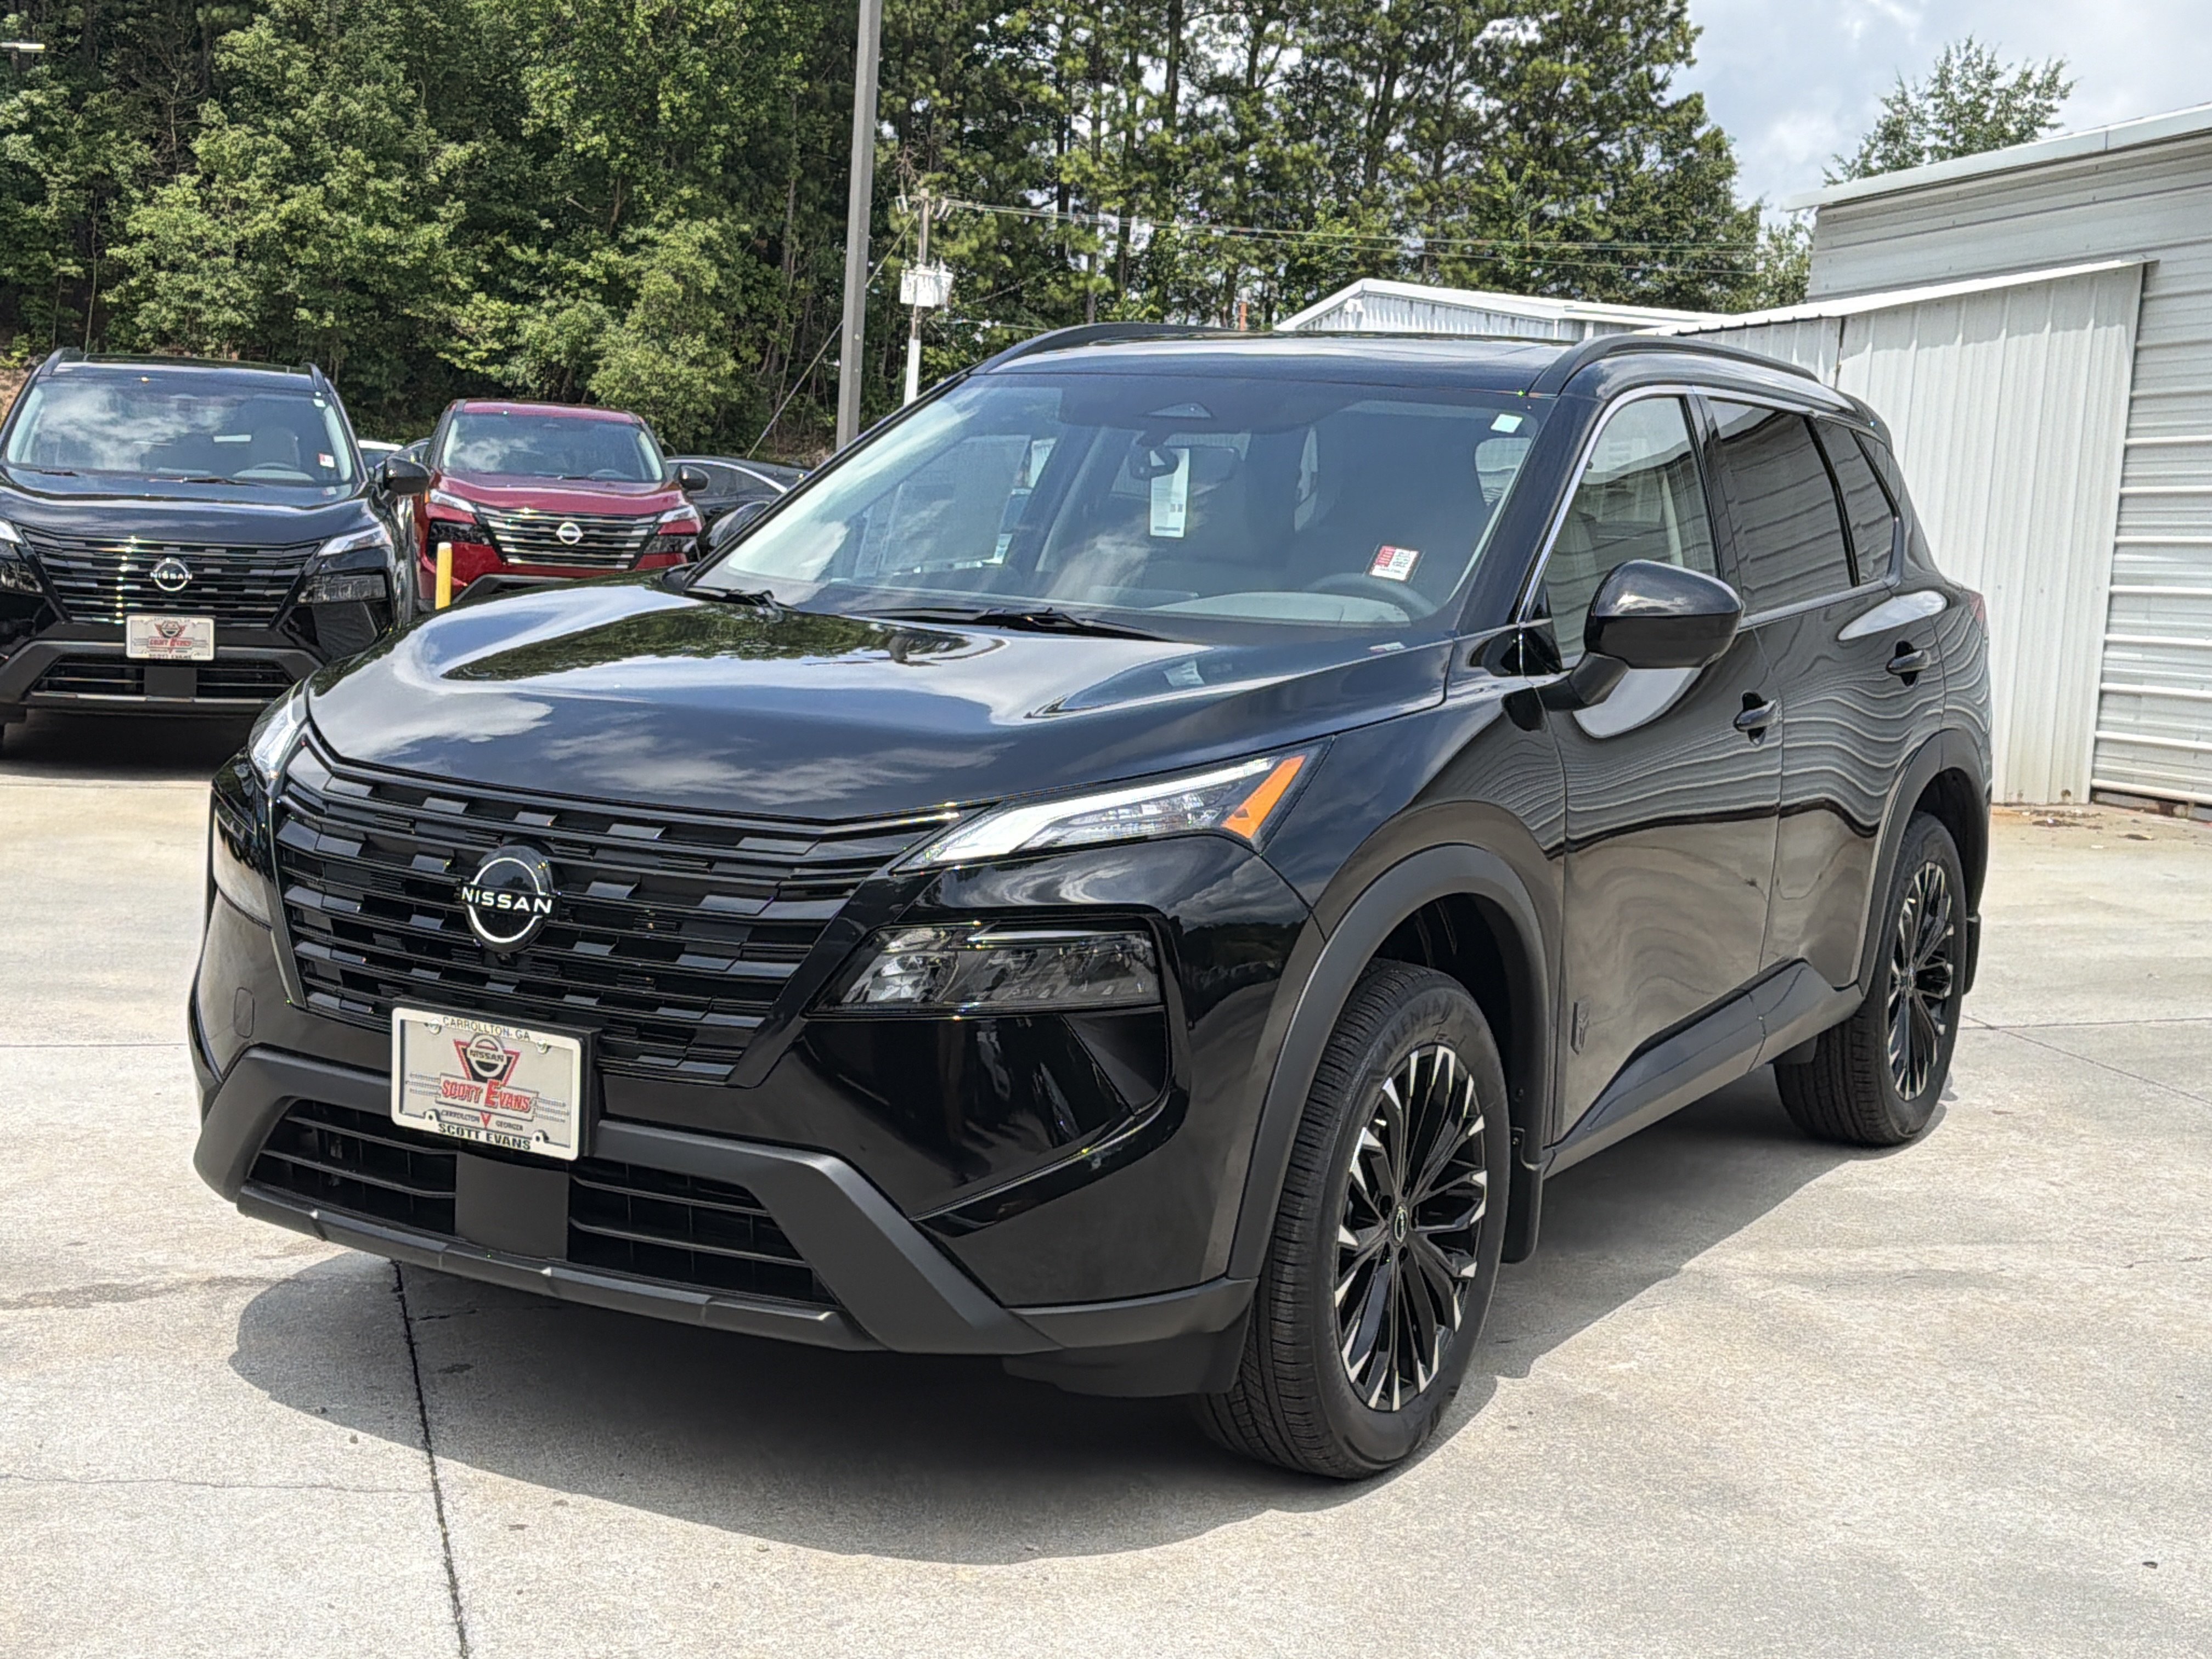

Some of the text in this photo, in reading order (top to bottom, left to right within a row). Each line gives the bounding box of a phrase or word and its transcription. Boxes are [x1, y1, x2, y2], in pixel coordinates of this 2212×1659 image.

[461, 886, 552, 914] NISSAN
[515, 1029, 531, 1041] GA
[470, 1049, 504, 1063] NISSAN
[442, 1079, 532, 1113] SCOTT EVANS
[438, 1124, 531, 1150] SCOTT EVANS
